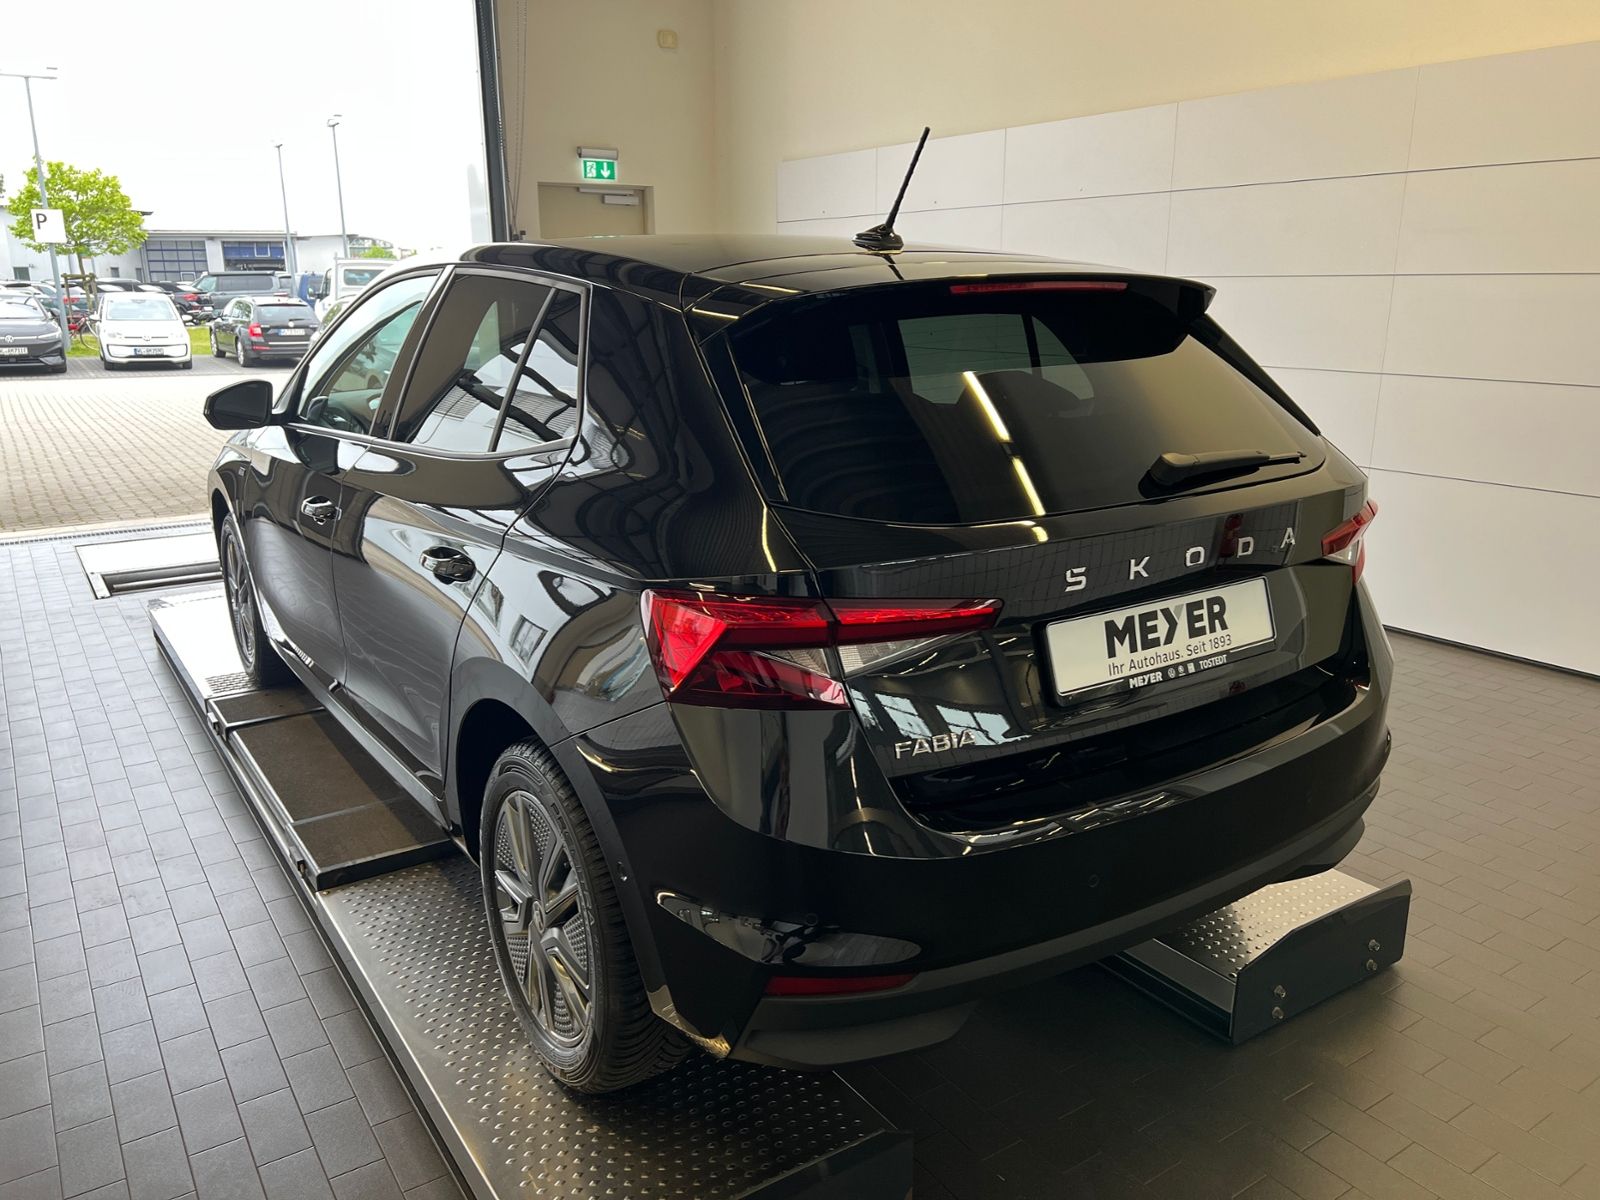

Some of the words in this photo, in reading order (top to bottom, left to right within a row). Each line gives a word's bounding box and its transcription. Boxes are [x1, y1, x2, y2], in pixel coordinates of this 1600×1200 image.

[36, 213, 47, 230] P
[1064, 527, 1296, 592] SKODA
[1104, 595, 1229, 659] MEYER
[1108, 662, 1125, 677] Ihr
[1128, 650, 1184, 672] Autohaus.
[1186, 639, 1207, 657] Seit
[1208, 634, 1233, 651] 1893
[1129, 671, 1163, 689] MEYER
[1198, 654, 1228, 670] TOSTEDT
[894, 728, 977, 760] FABIA
